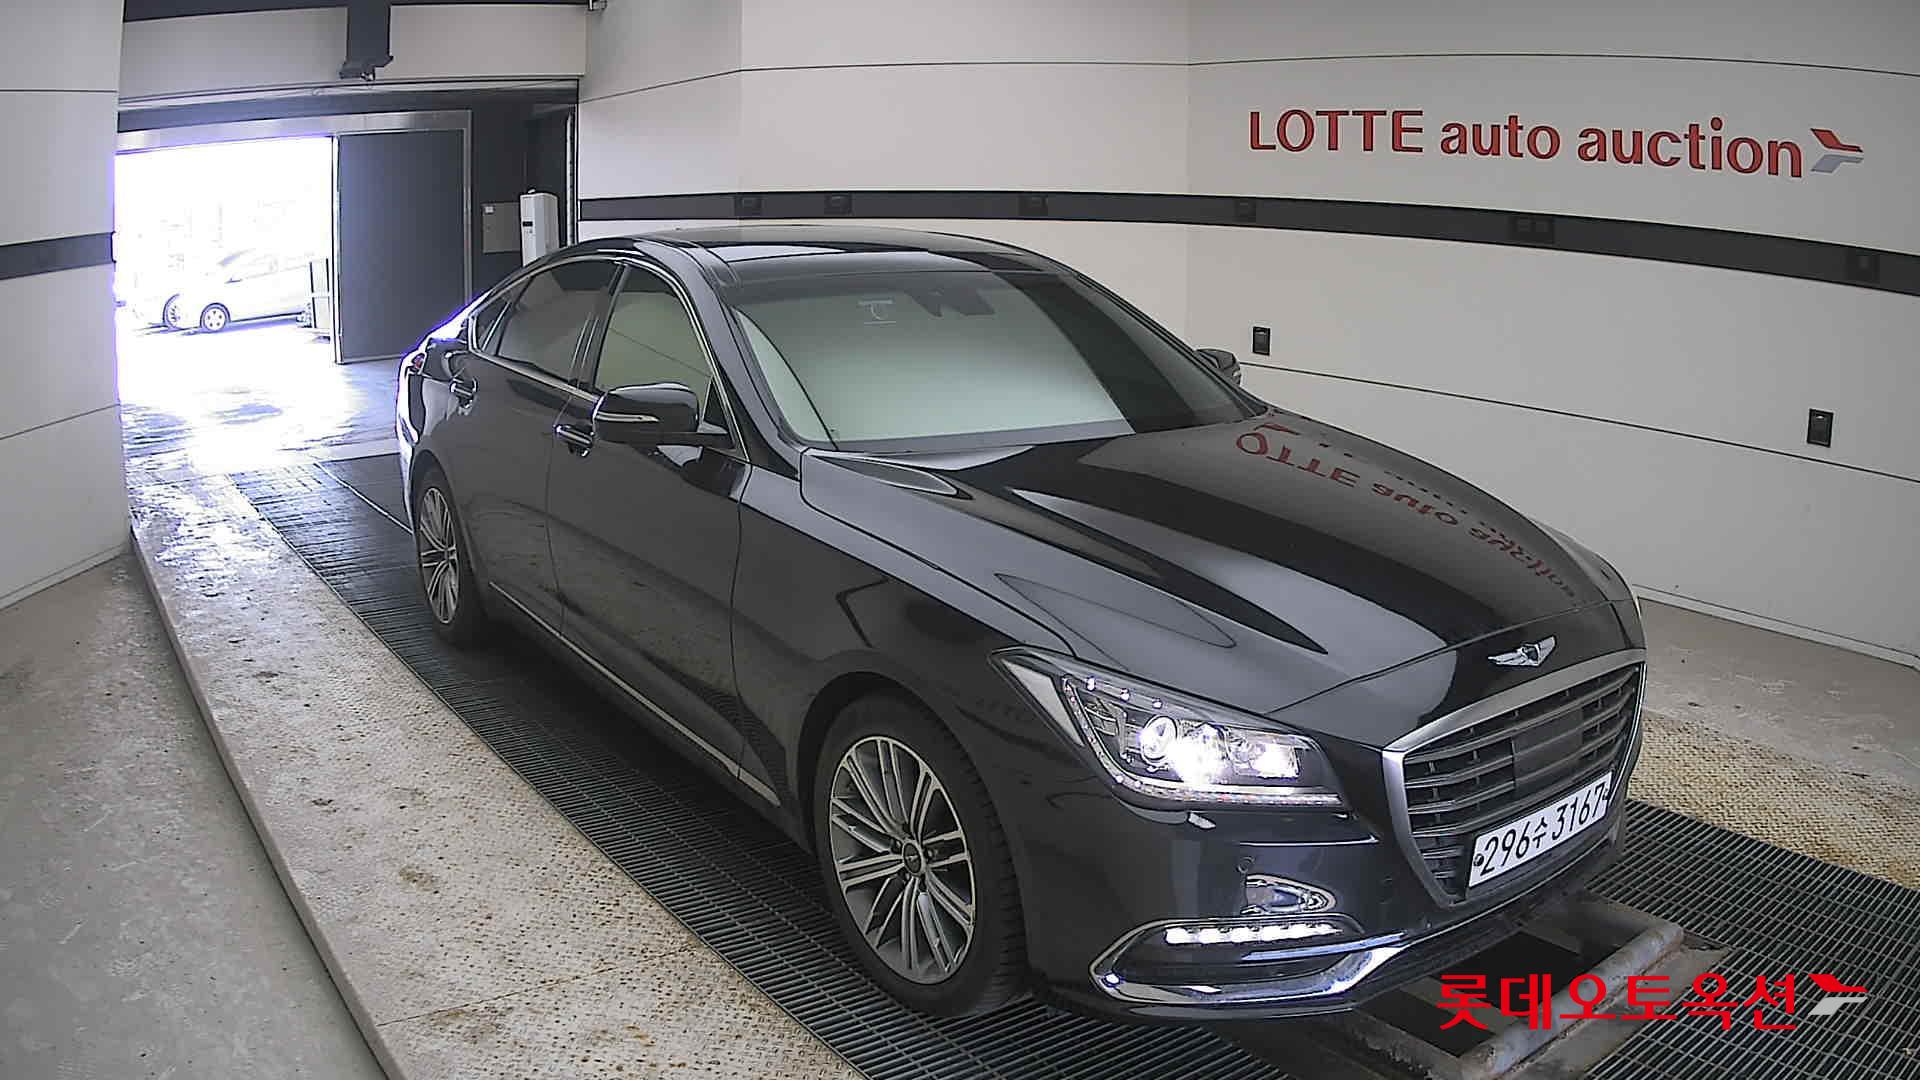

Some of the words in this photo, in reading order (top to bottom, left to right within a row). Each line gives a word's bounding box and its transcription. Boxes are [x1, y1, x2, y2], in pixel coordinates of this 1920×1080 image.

[1249, 109, 1424, 153] LOTTE
[1440, 114, 1561, 160] auto
[1577, 116, 1802, 178] auction
